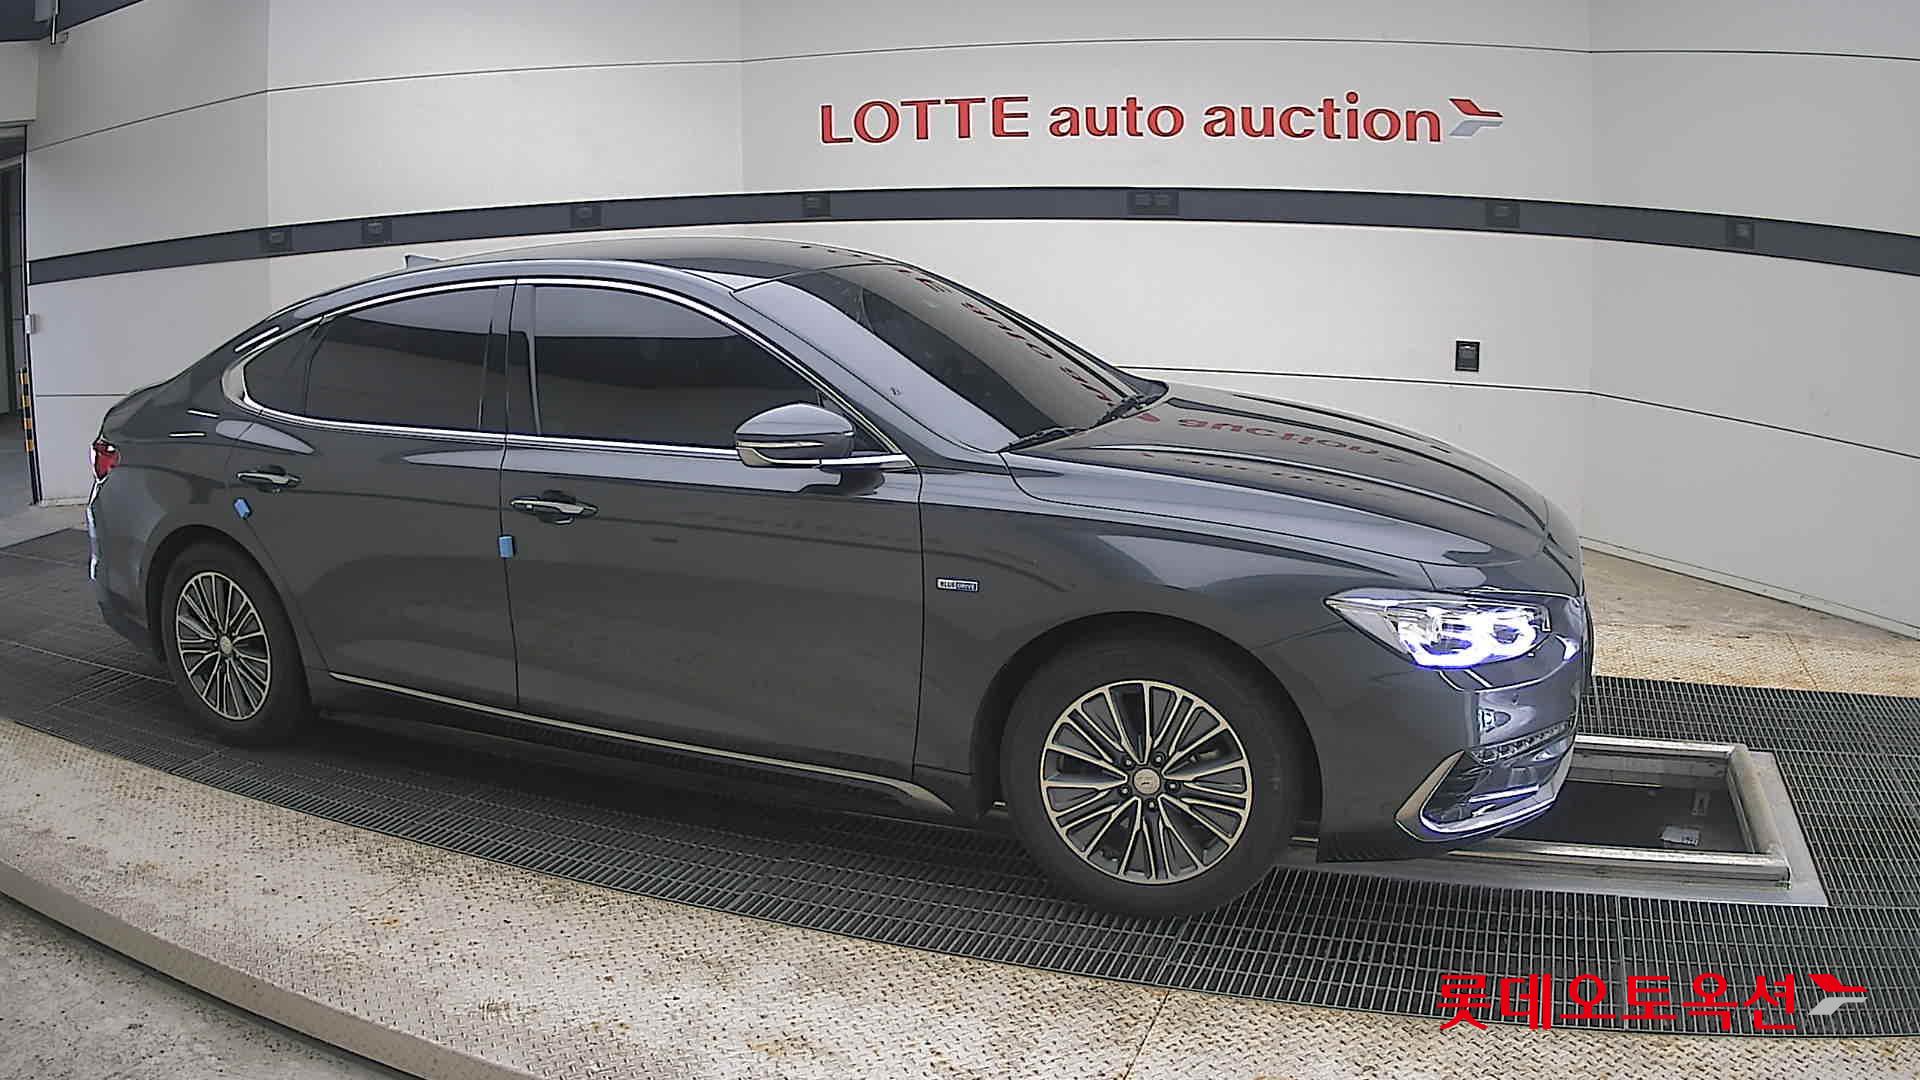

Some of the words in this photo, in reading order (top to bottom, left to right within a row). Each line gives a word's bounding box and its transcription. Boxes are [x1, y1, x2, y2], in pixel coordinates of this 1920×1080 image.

[819, 95, 1030, 145] LOTTE
[1048, 95, 1186, 138] auto
[1202, 91, 1442, 143] auction
